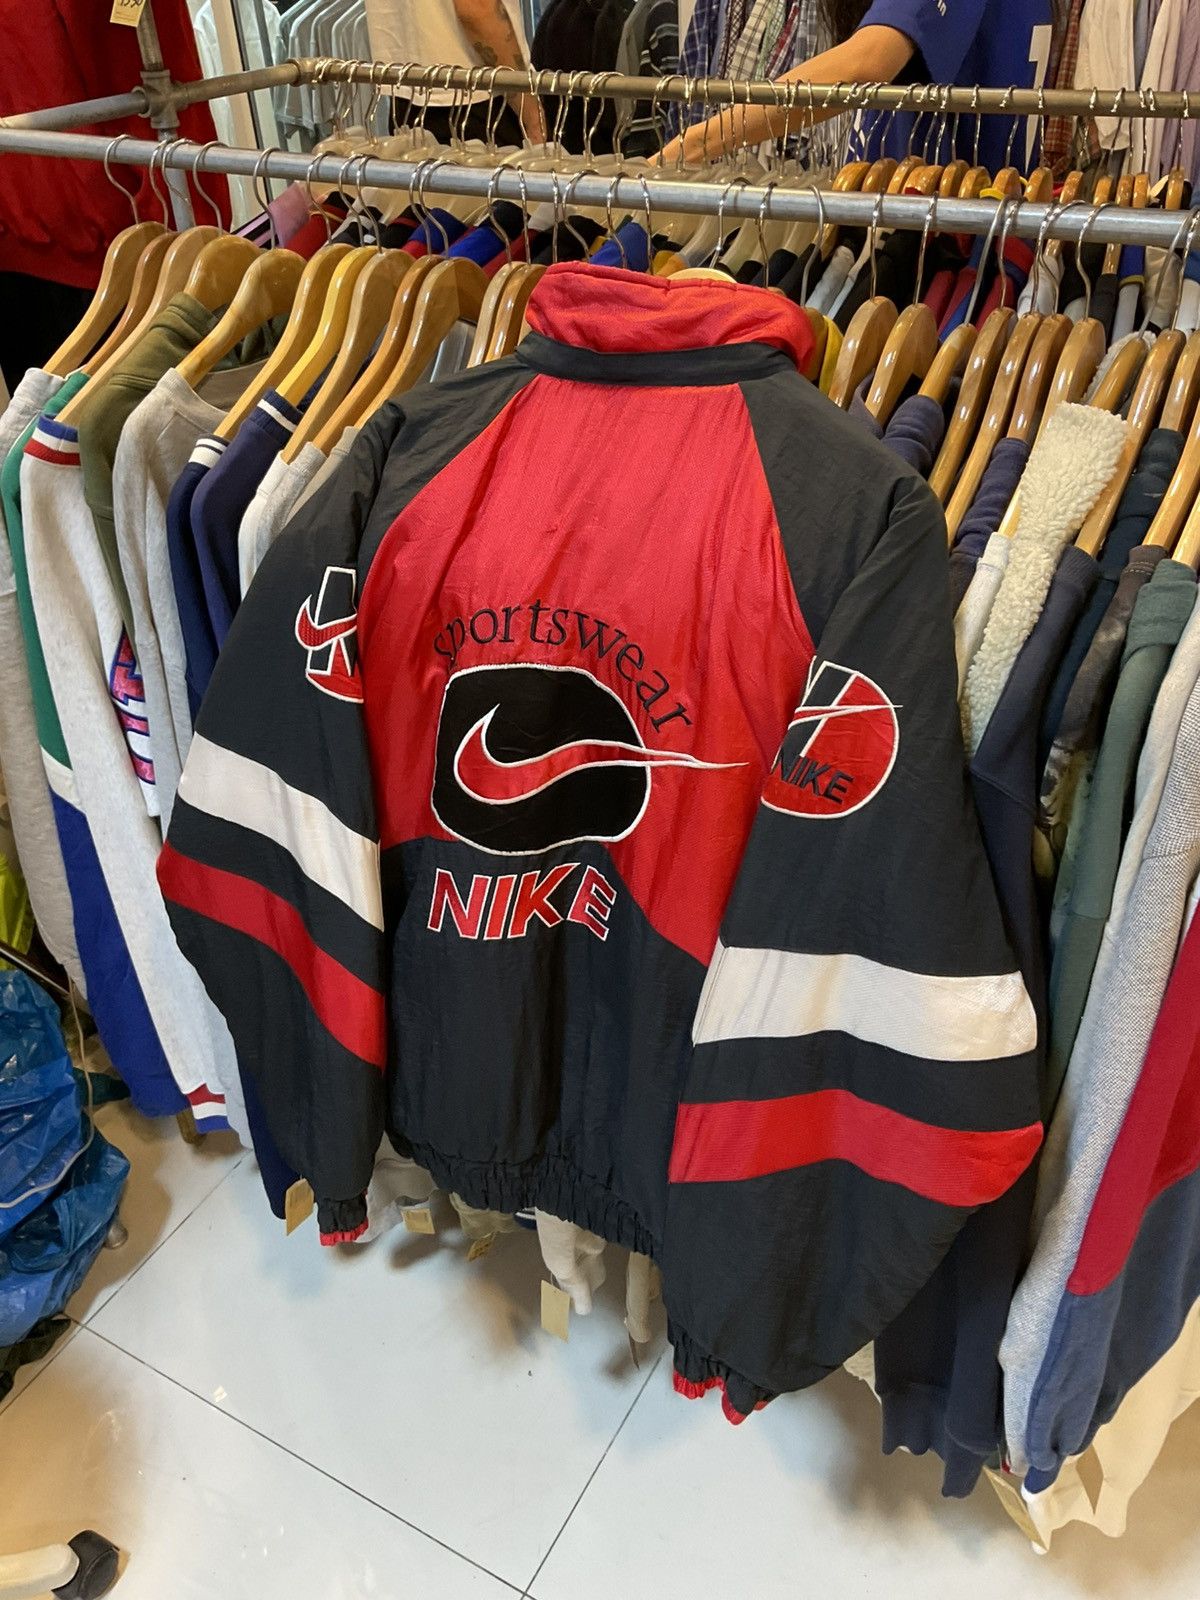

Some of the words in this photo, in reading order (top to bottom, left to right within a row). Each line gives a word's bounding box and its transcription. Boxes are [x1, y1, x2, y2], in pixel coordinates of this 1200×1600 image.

[433, 599, 693, 733] sportswear
[772, 748, 854, 805] NIKE
[427, 862, 617, 941] NIKE
